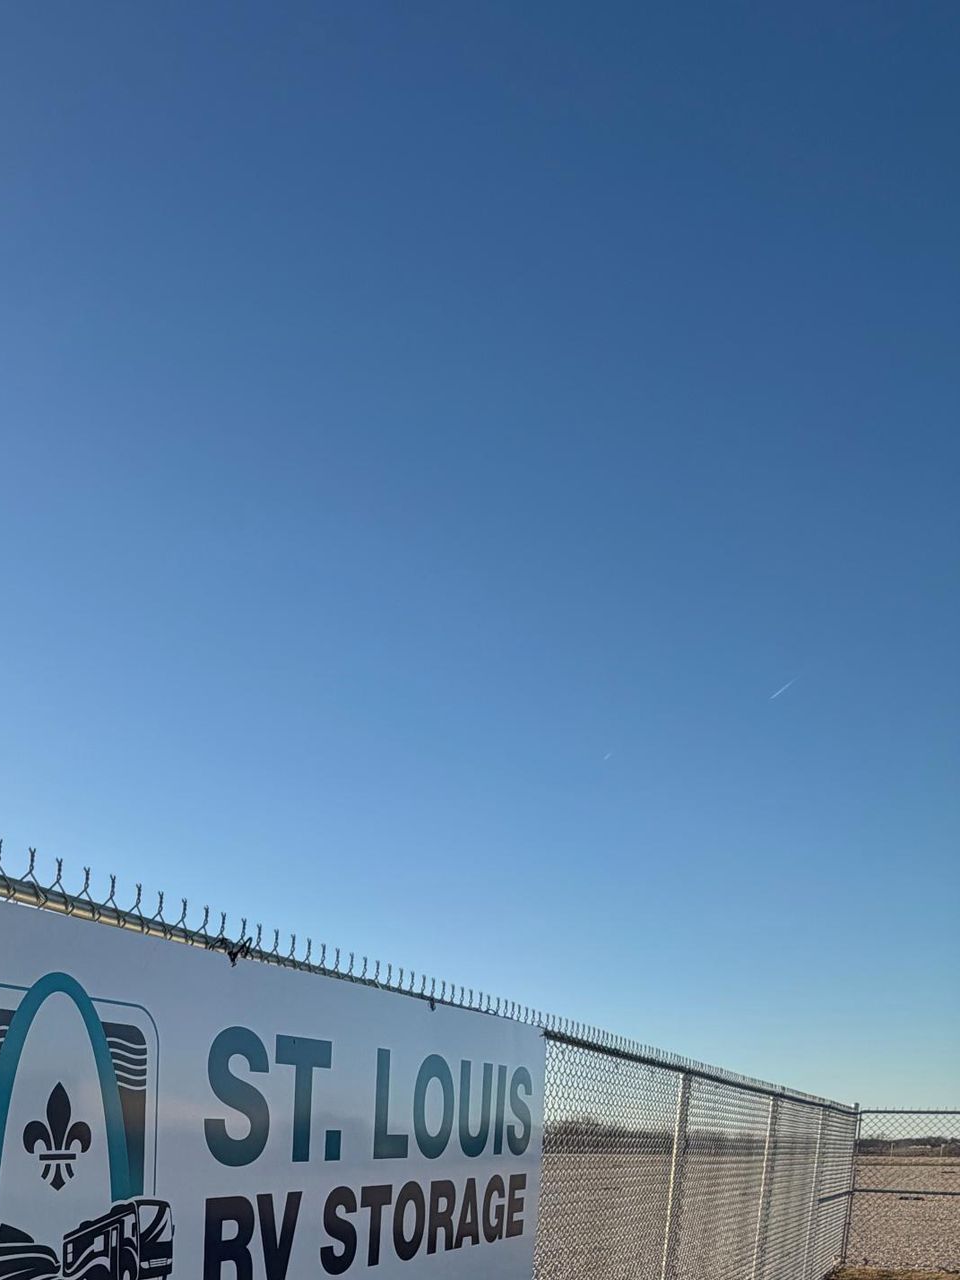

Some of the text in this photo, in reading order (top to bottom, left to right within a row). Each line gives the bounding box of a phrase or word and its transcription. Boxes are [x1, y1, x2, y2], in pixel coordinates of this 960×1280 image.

[204, 1026, 533, 1167] ST. LOUIS
[319, 1174, 527, 1275] STORAGE
